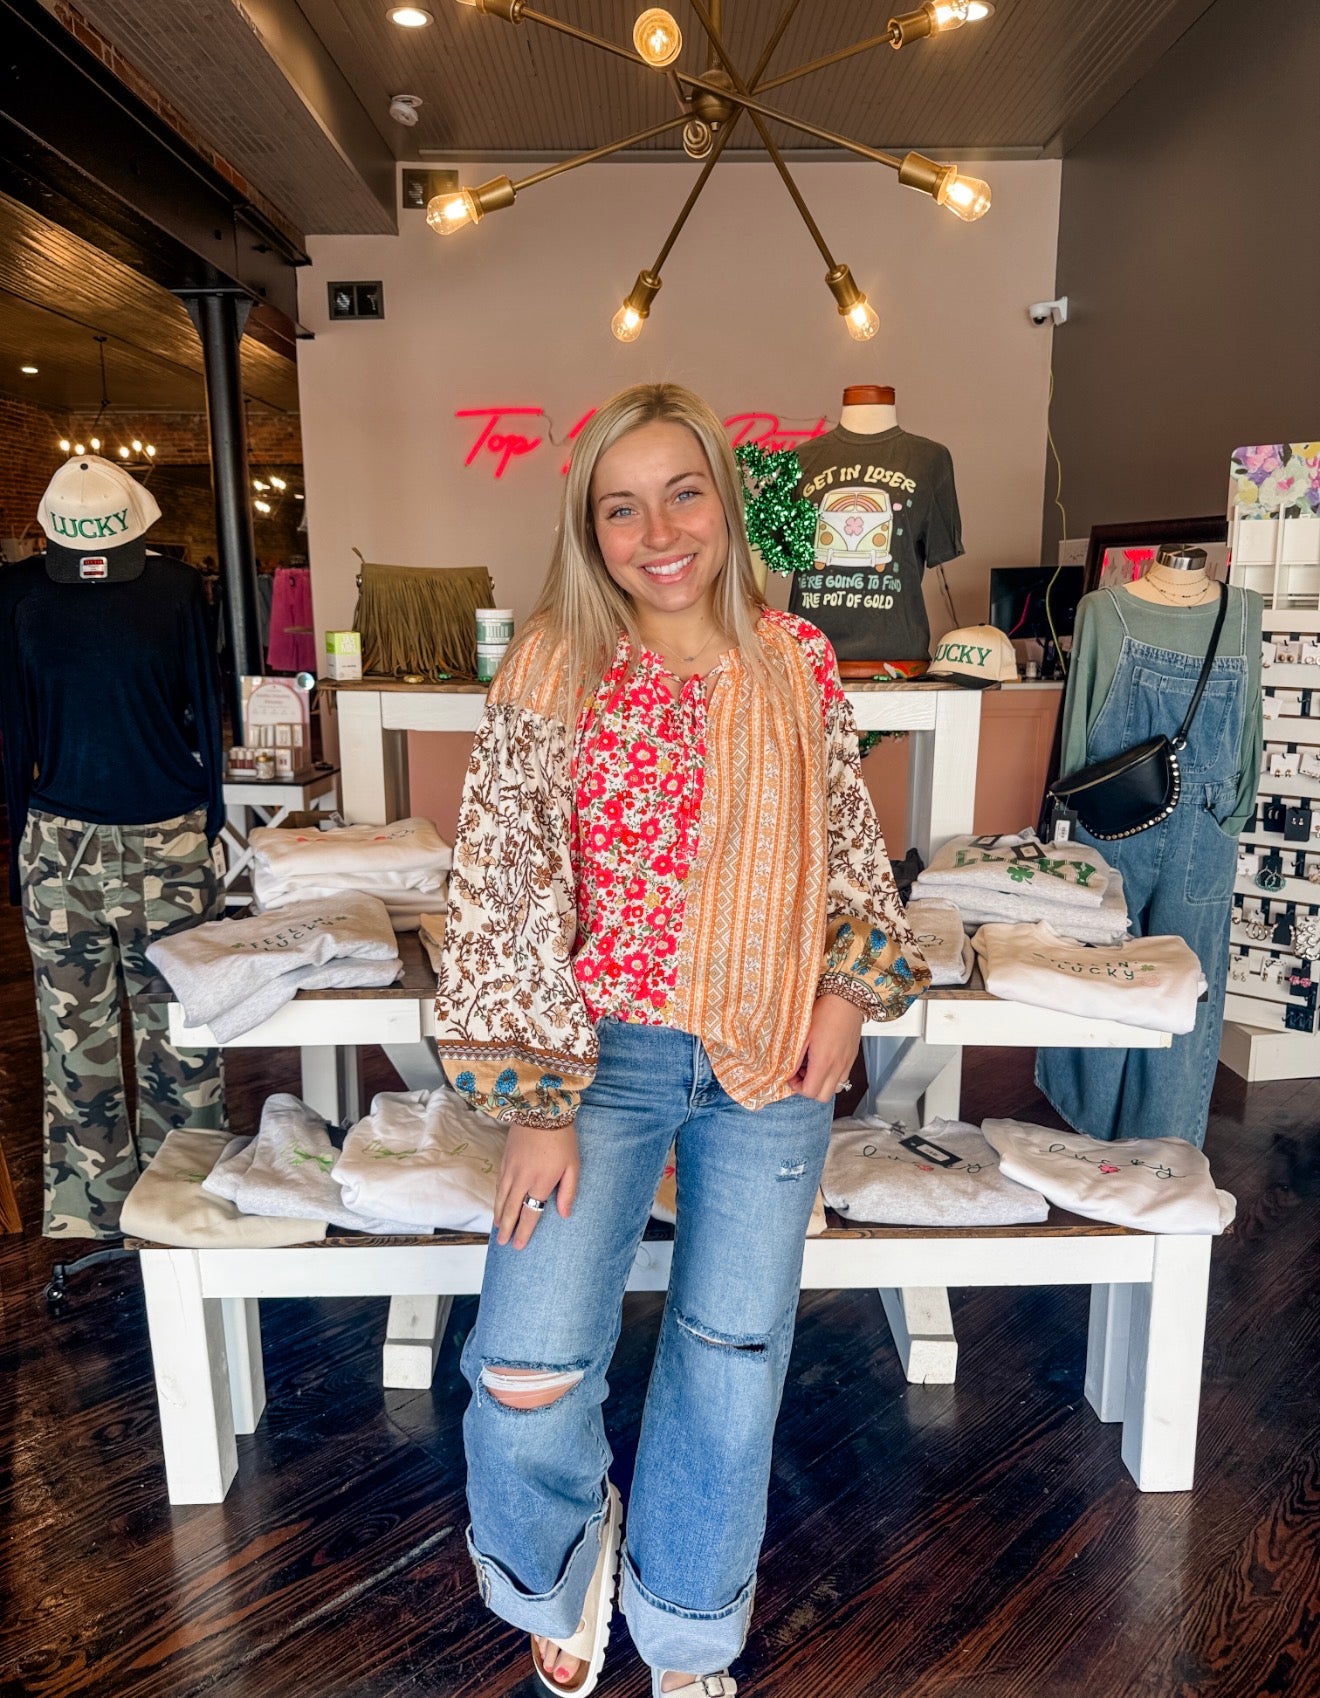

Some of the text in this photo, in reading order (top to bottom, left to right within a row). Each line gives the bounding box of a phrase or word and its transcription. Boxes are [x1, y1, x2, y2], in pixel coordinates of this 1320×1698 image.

[455, 407, 543, 479] Top
[803, 464, 916, 497] GET IN LOSER
[50, 508, 129, 538] LUCKY
[799, 573, 902, 592] E'RE GOING TO FIND
[801, 591, 894, 609] THE POT OF GOLD
